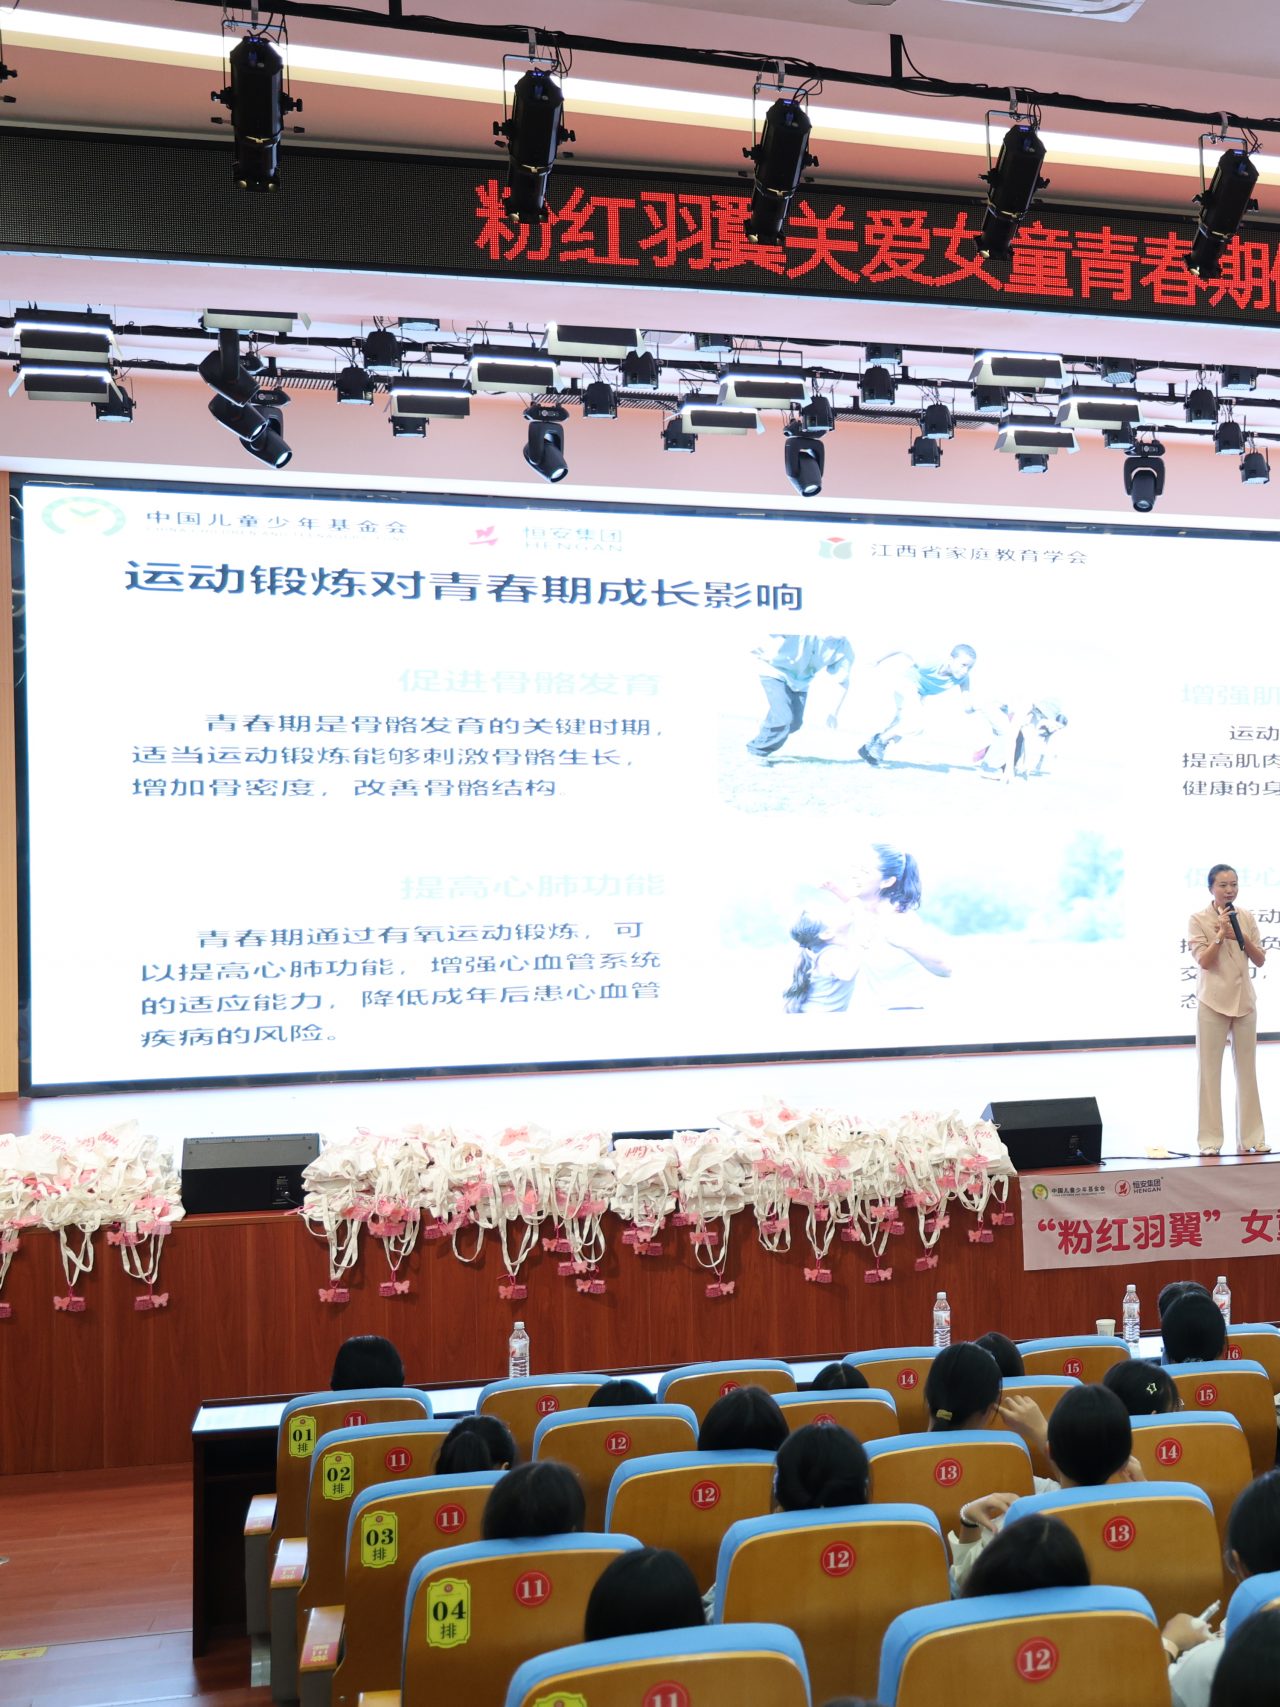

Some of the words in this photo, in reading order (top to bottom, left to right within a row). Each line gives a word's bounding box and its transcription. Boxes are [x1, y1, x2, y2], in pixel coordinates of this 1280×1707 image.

[146, 510, 409, 535] 中国儿童少年基金会
[870, 542, 1089, 565] 江西省家庭教育学会
[123, 560, 804, 613] 运动锻炼对青春期成长影响
[397, 668, 663, 697] 促进骨骼发育
[400, 872, 667, 901] 提高心肺功能
[1068, 1363, 1079, 1373] 15
[901, 1375, 914, 1385] 14
[1200, 1389, 1213, 1401] 15
[542, 1401, 555, 1411] 12
[292, 1428, 313, 1442] 01
[297, 1443, 309, 1453] 排
[611, 1438, 626, 1450] 12
[1161, 1445, 1177, 1459] 14
[391, 1454, 406, 1466] 11
[326, 1466, 351, 1482] 02
[940, 1466, 957, 1480] 13
[333, 1482, 345, 1495] 排
[697, 1488, 715, 1502] 12
[442, 1512, 459, 1526] 11
[366, 1528, 394, 1546] 03
[1110, 1525, 1129, 1542] 13
[372, 1547, 387, 1560] 排
[828, 1551, 849, 1568] 12
[523, 1580, 543, 1598] 11
[432, 1599, 467, 1622] 04
[440, 1623, 457, 1640] 排
[1024, 1649, 1050, 1672] 12
